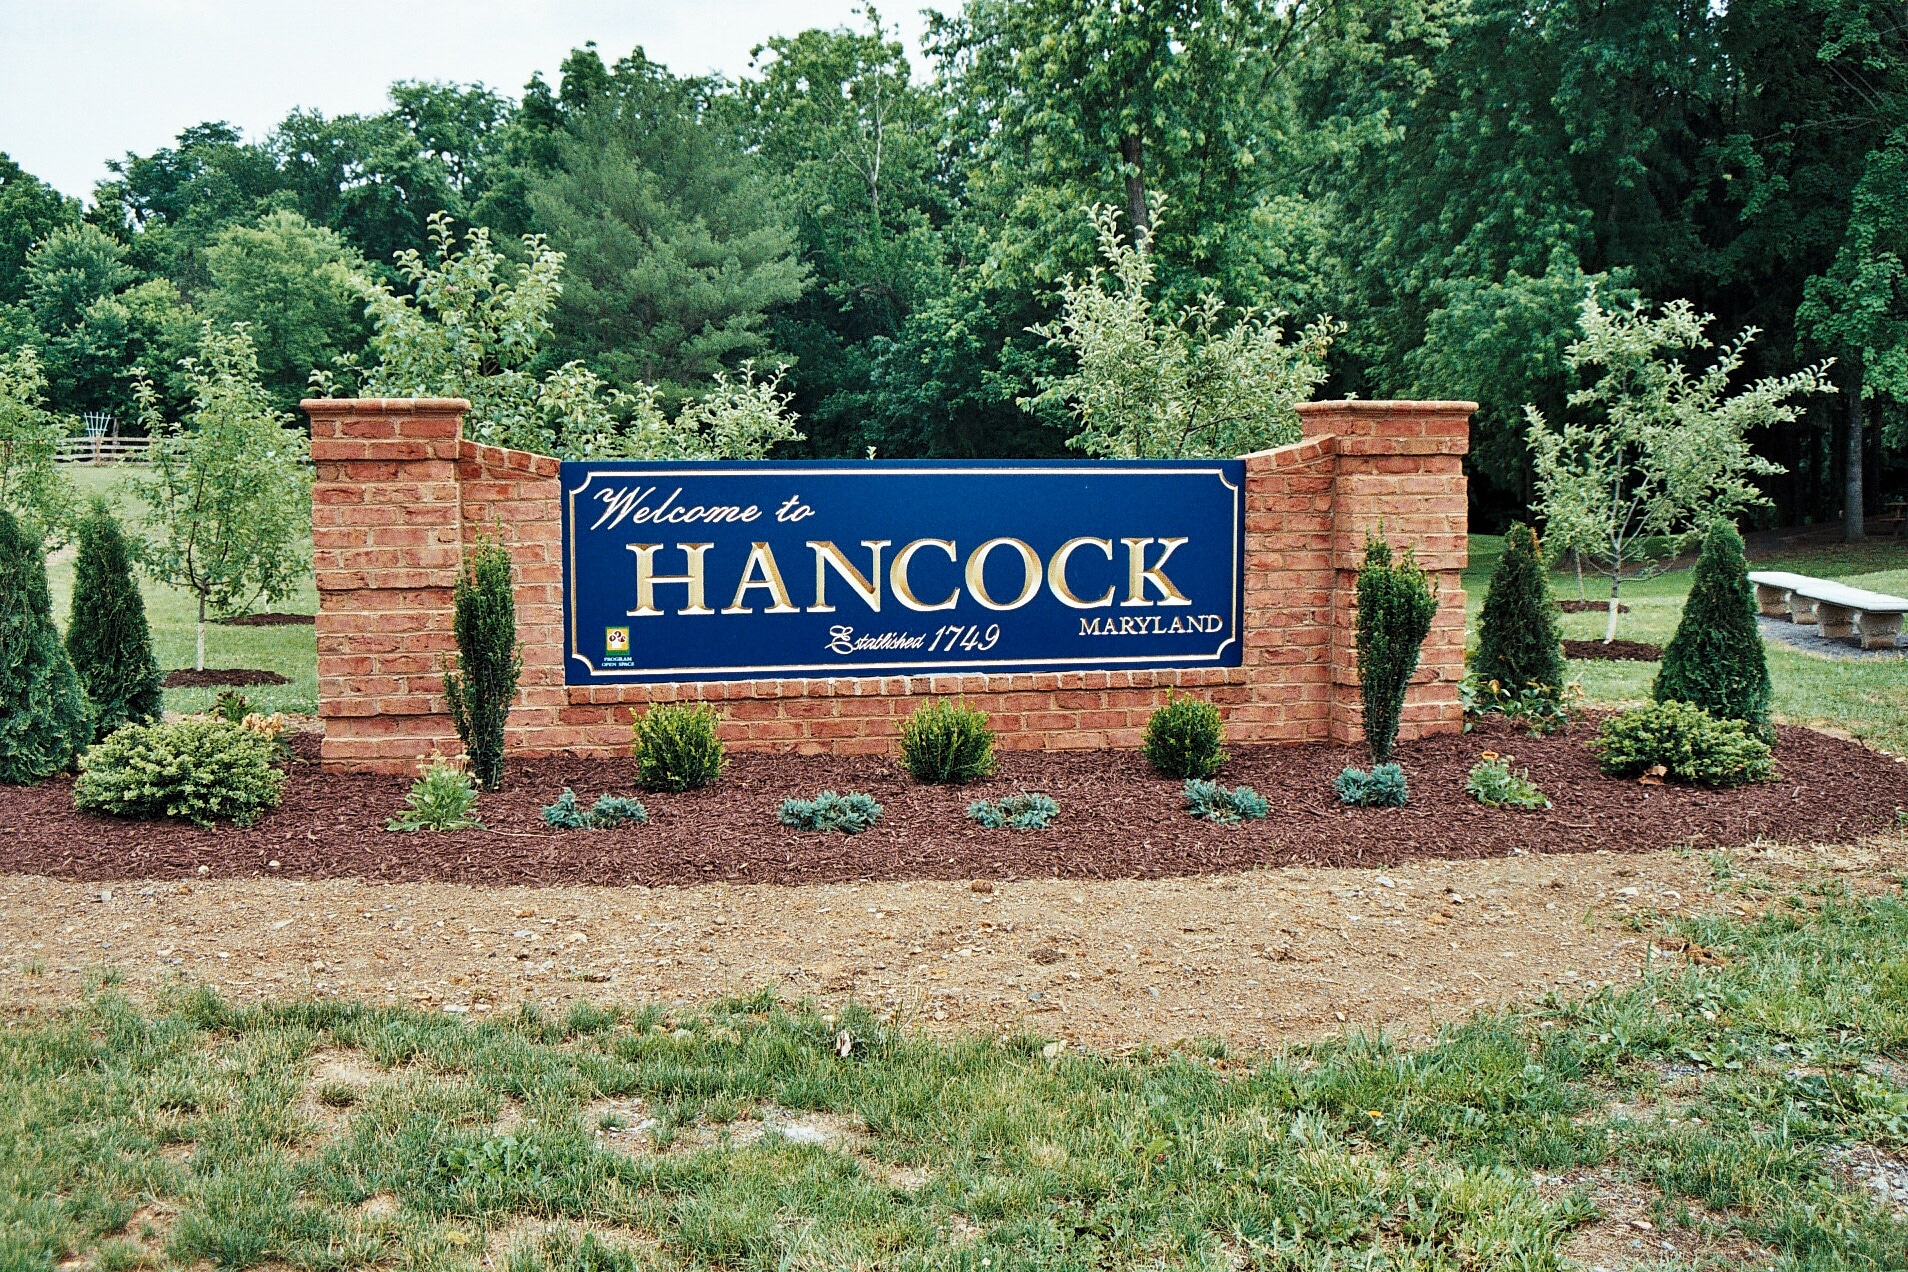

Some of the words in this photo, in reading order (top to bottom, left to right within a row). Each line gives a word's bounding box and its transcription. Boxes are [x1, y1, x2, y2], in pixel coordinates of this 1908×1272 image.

[590, 486, 762, 531] Welcome
[776, 494, 815, 523] to
[625, 536, 1193, 617] HANCOCK
[825, 624, 926, 655] Established
[927, 624, 1001, 652] 1749
[1078, 615, 1223, 636] MARYLAND
